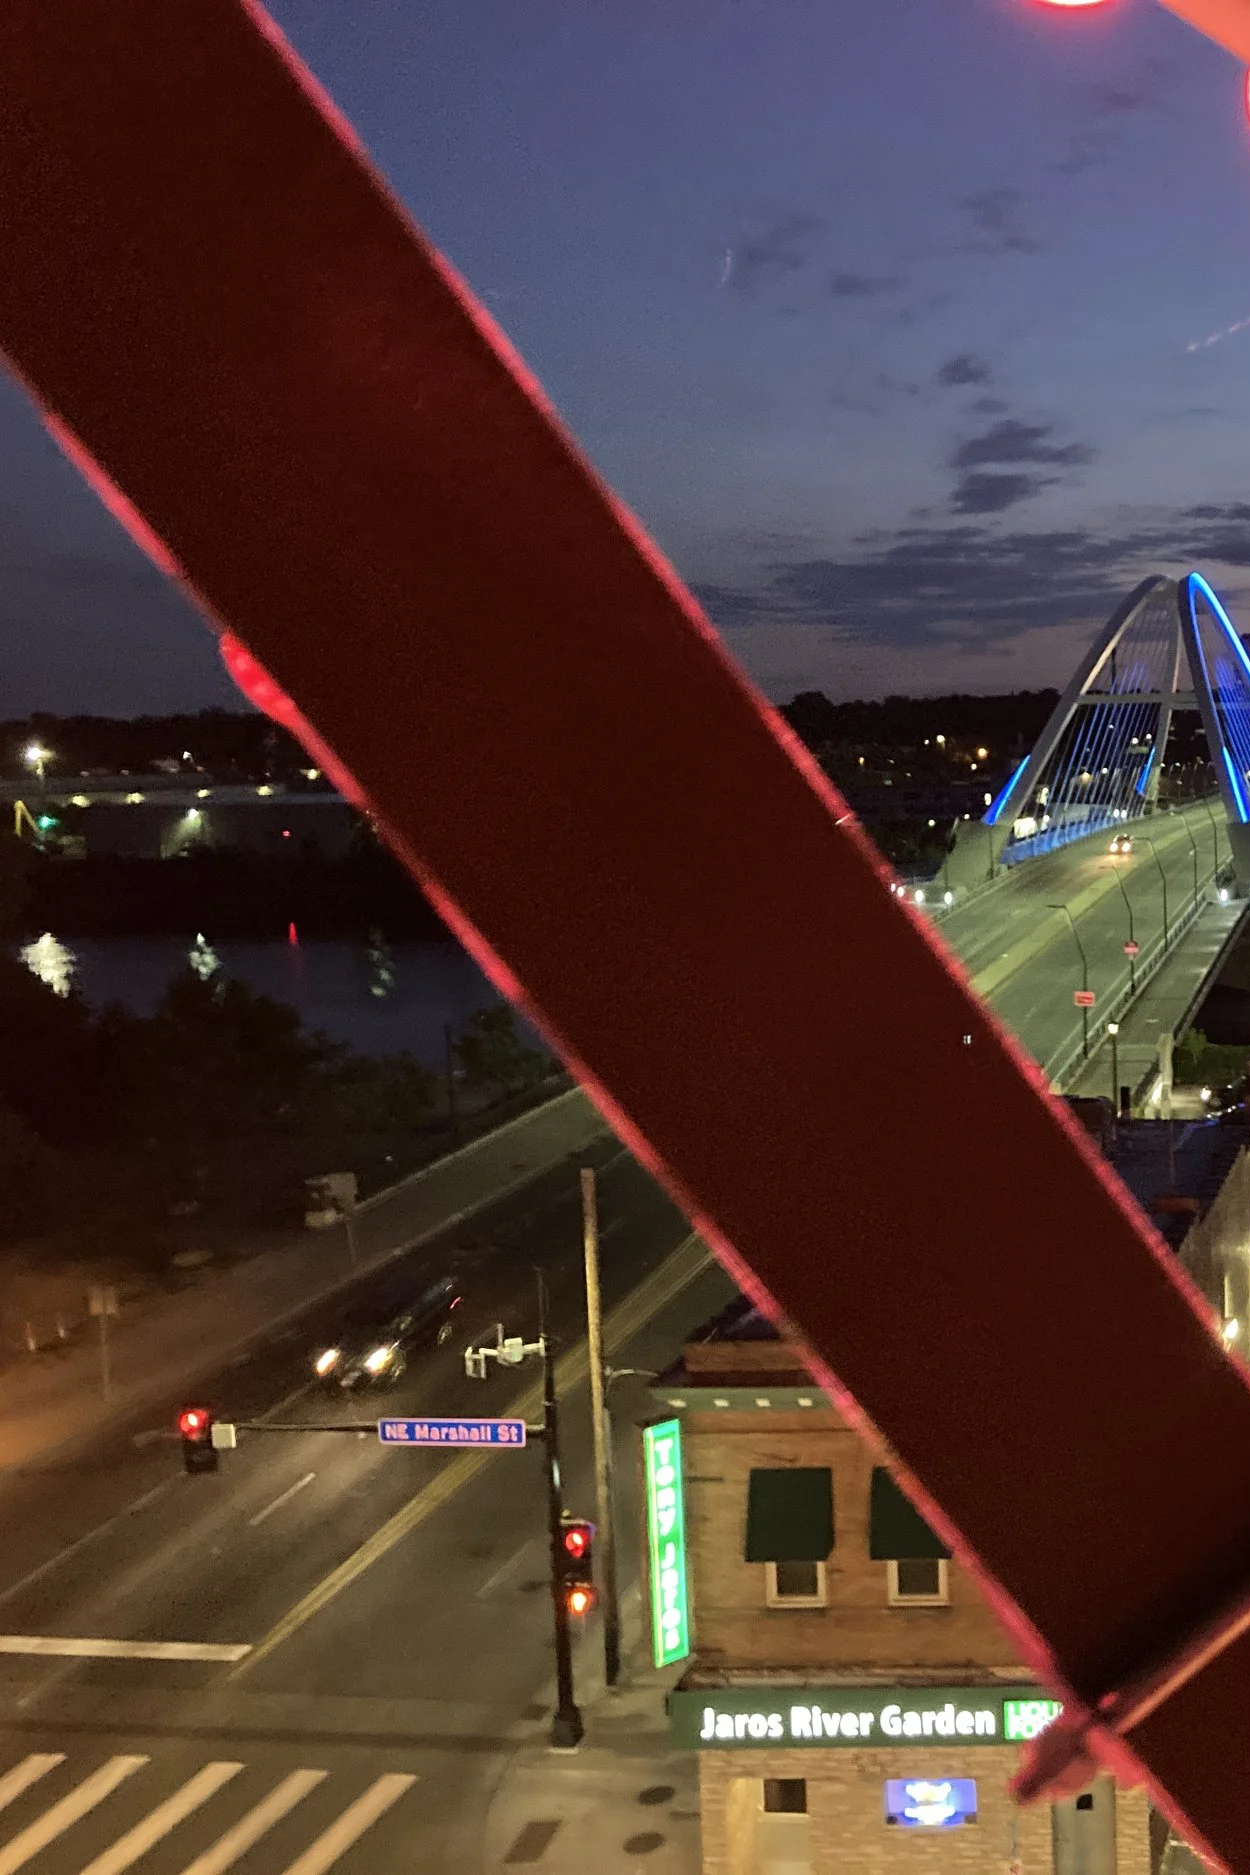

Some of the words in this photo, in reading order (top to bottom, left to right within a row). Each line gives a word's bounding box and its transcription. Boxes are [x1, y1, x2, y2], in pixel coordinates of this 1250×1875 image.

[384, 1423, 409, 1440] NE
[414, 1423, 492, 1442] Marshall
[497, 1424, 519, 1442] St
[699, 1706, 784, 1739] Jaros
[790, 1705, 874, 1738] River
[880, 1703, 996, 1737] Garden
